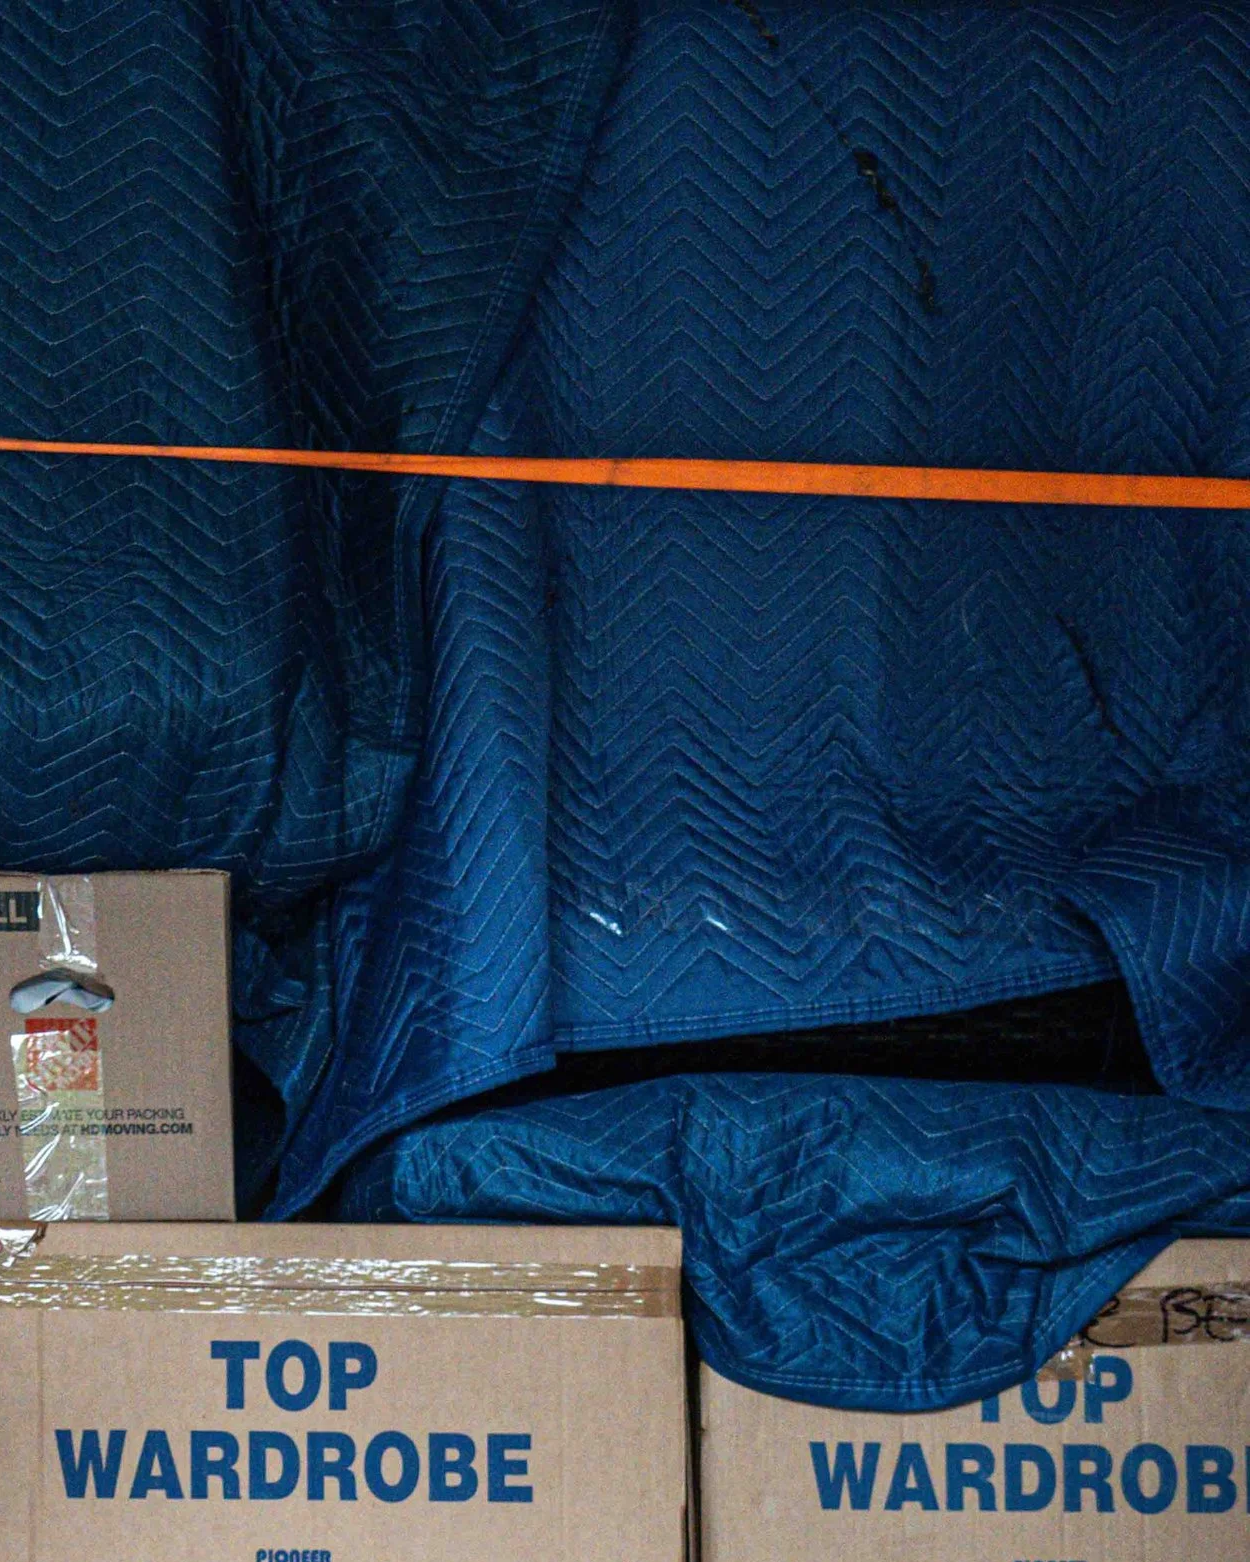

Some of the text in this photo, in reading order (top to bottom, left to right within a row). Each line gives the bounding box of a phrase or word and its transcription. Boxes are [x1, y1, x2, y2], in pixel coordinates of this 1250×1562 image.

[63, 1124, 80, 1136] AT
[80, 1122, 193, 1136] HDMOVING.COM
[86, 1108, 123, 1121] YOUR
[126, 1107, 184, 1120] PACKING
[210, 1339, 379, 1413] TOP
[54, 1428, 535, 1505] WARDROBE
[809, 1441, 1250, 1515] WARDROB
